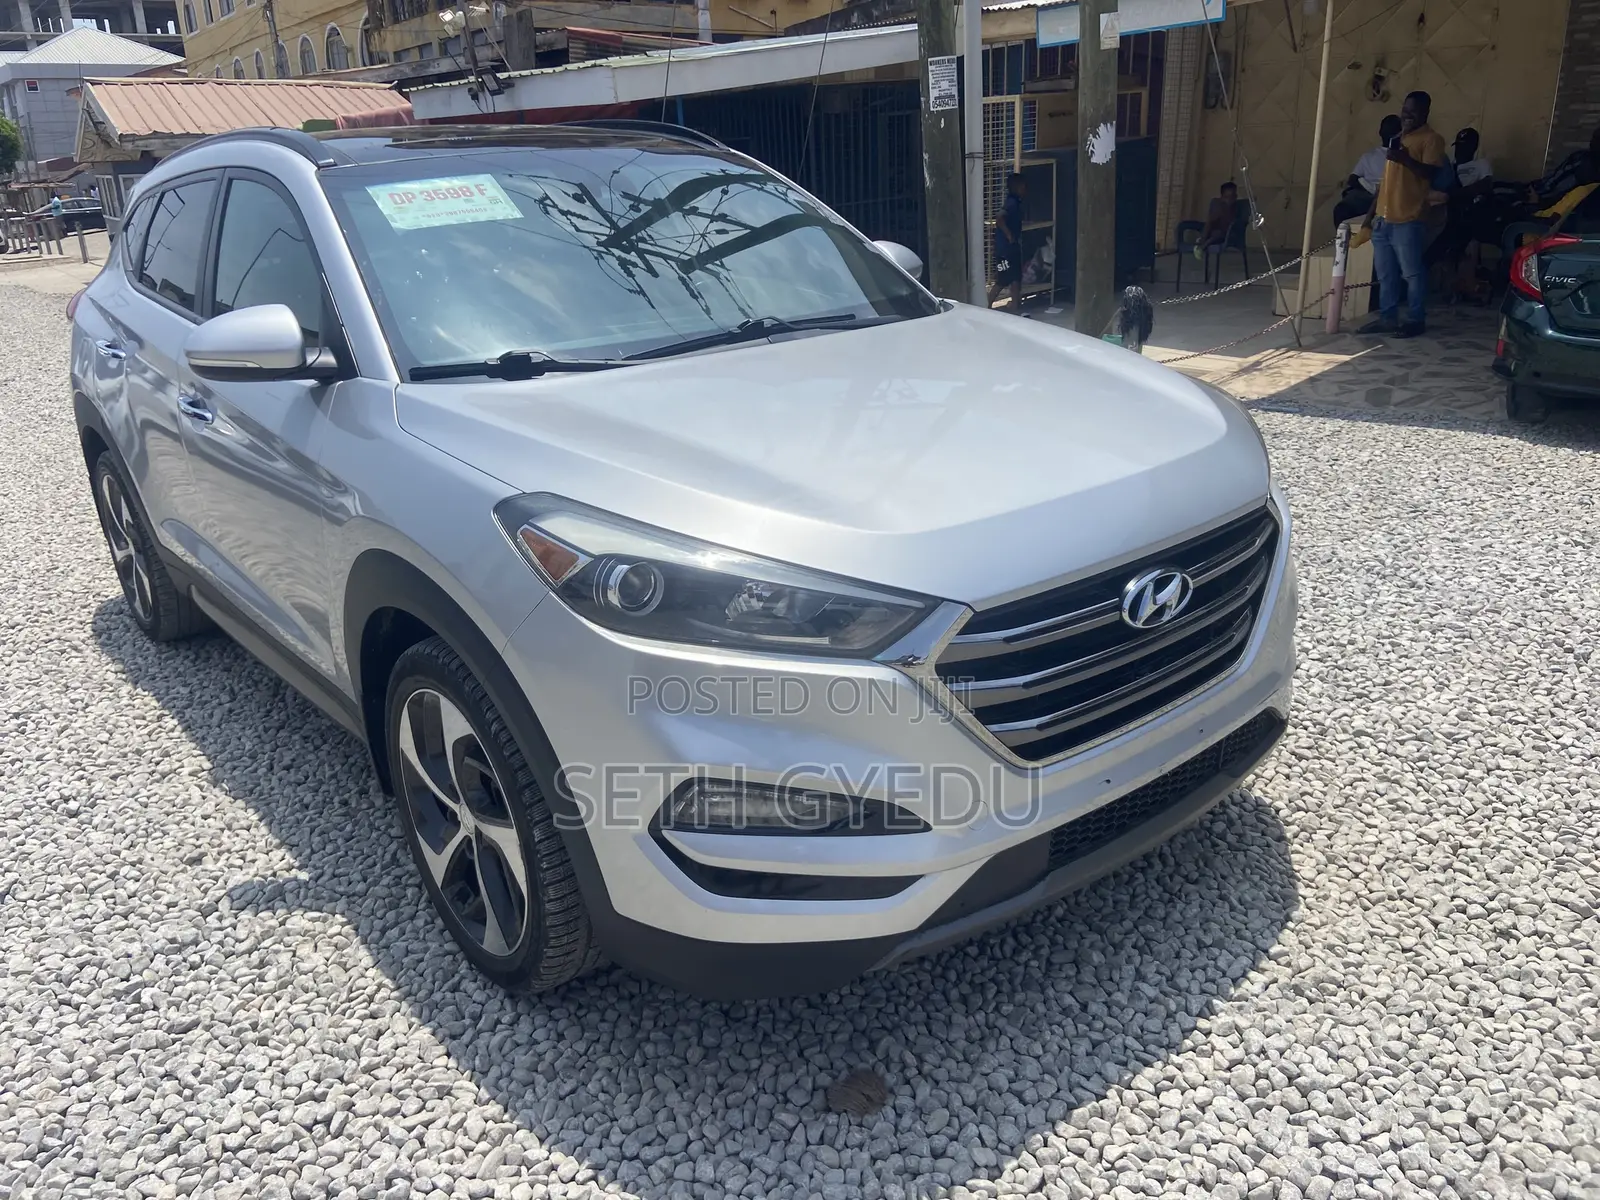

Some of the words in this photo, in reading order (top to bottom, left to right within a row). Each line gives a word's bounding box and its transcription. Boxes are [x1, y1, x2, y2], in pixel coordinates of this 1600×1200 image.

[388, 191, 417, 205] DP
[420, 186, 474, 201] 3598
[475, 183, 487, 196] F
[997, 259, 1010, 272] sit
[1544, 275, 1577, 284] CIVIC
